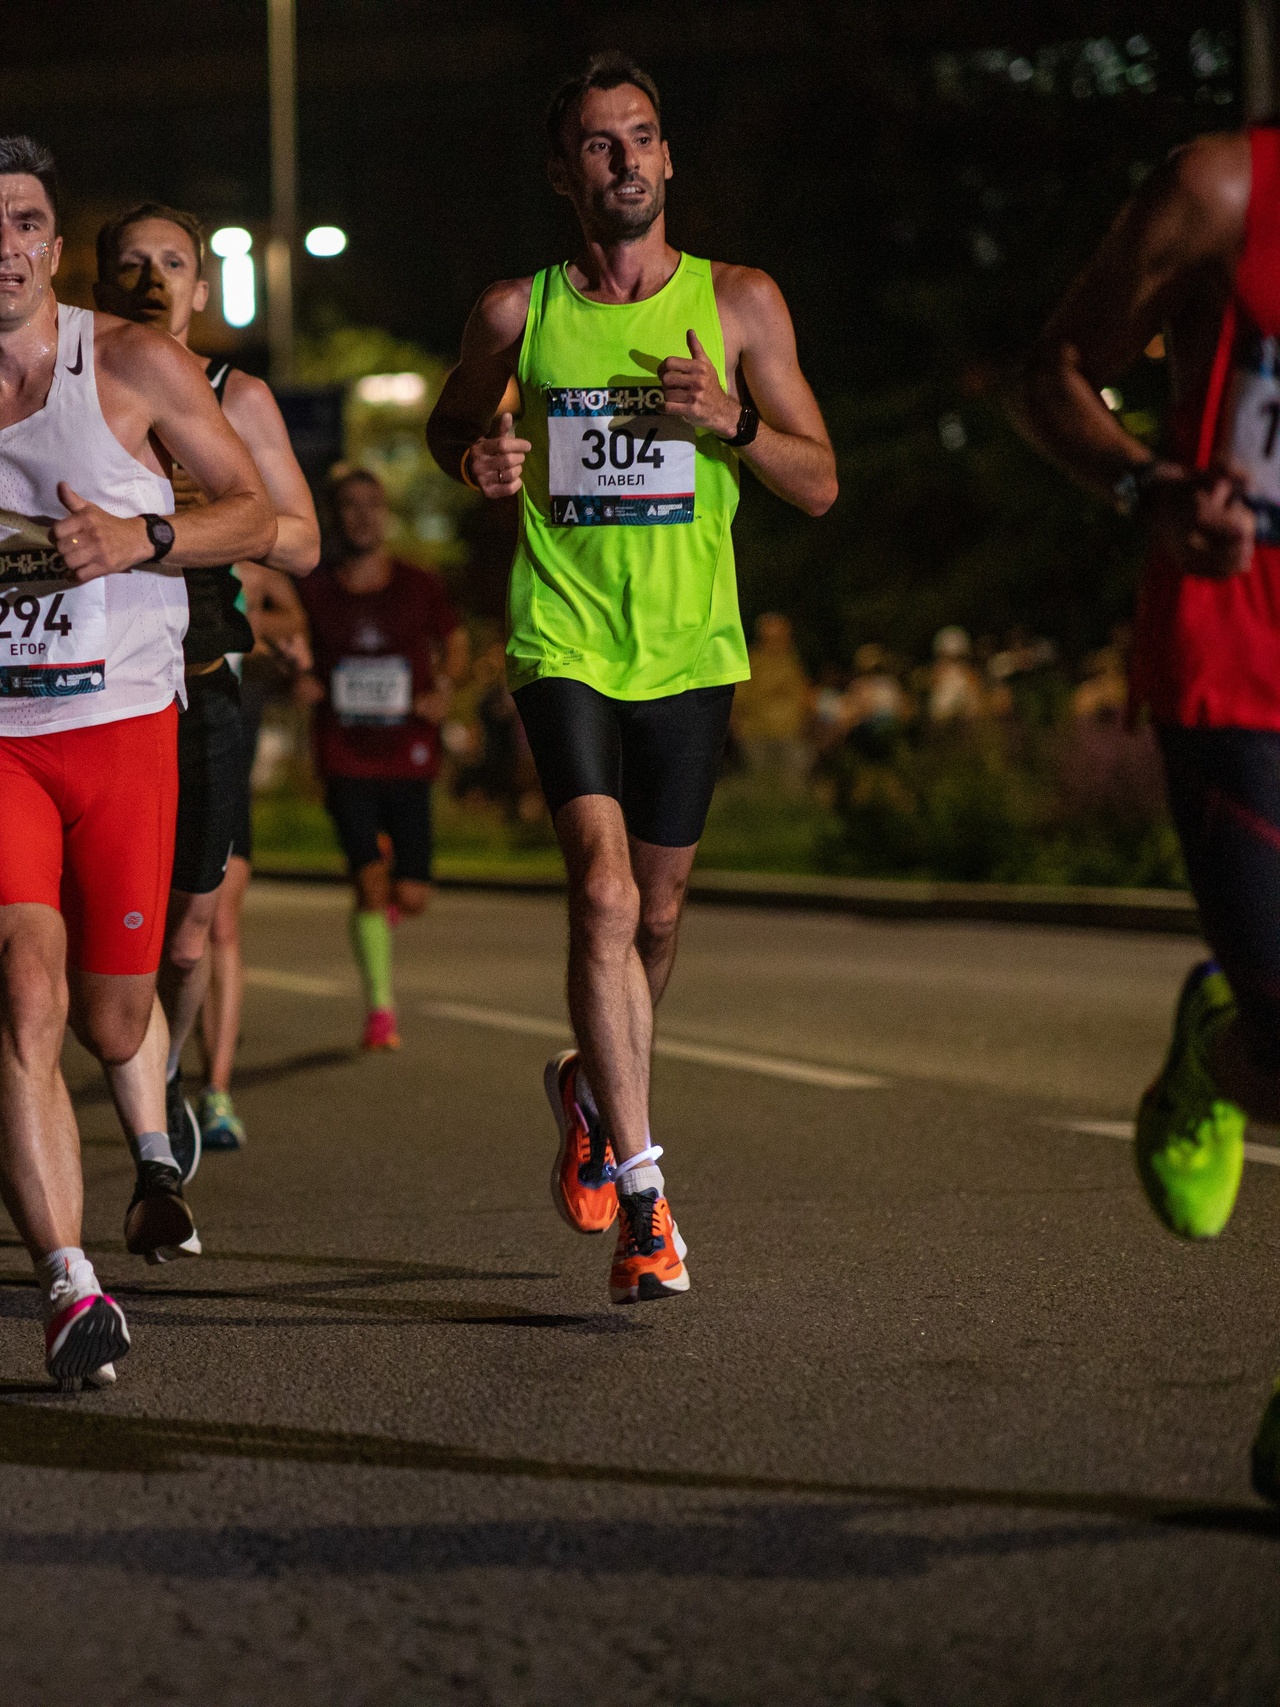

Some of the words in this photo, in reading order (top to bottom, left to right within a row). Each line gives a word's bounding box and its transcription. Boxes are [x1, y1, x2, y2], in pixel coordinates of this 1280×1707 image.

[581, 428, 664, 470] 304
[597, 474, 645, 487] ПАВЕЛ
[10, 643, 47, 656] ЕГОР
